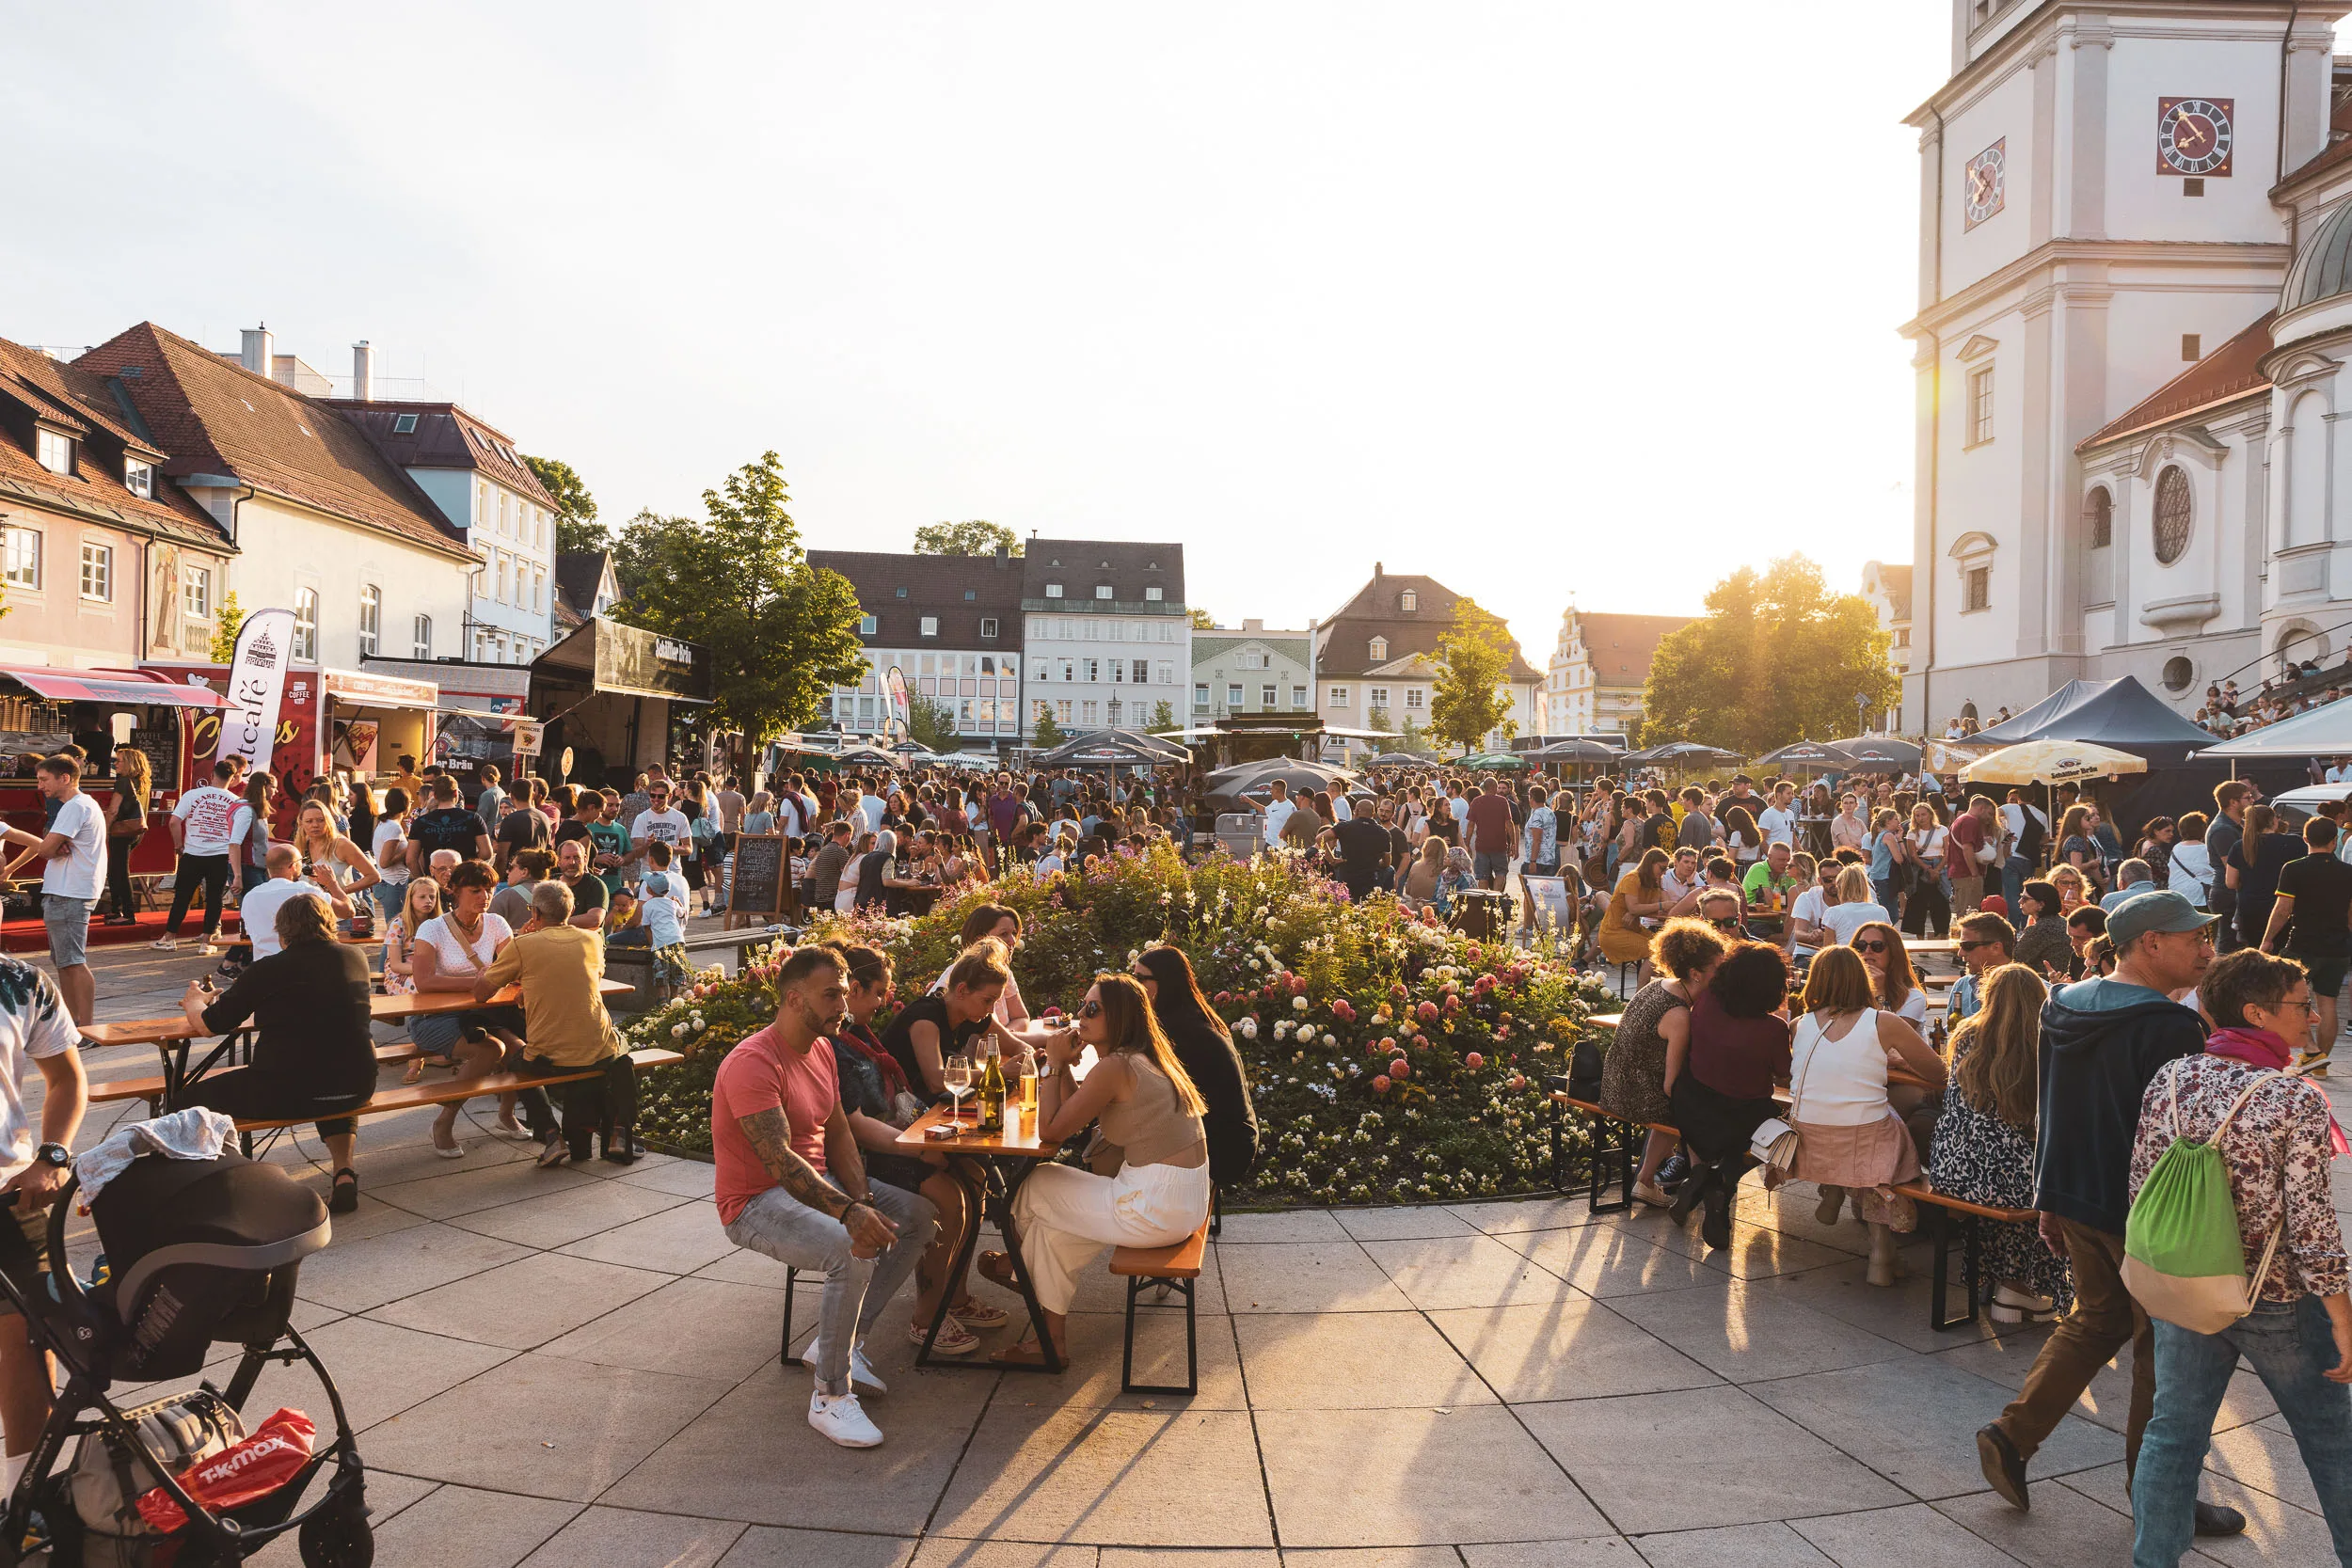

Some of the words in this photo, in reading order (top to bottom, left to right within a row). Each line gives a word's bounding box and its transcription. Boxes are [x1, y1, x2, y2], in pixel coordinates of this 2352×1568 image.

[288, 690, 310, 699] COFFEE
[449, 758, 473, 770] Bräu
[2051, 770, 2080, 779] Schäffler
